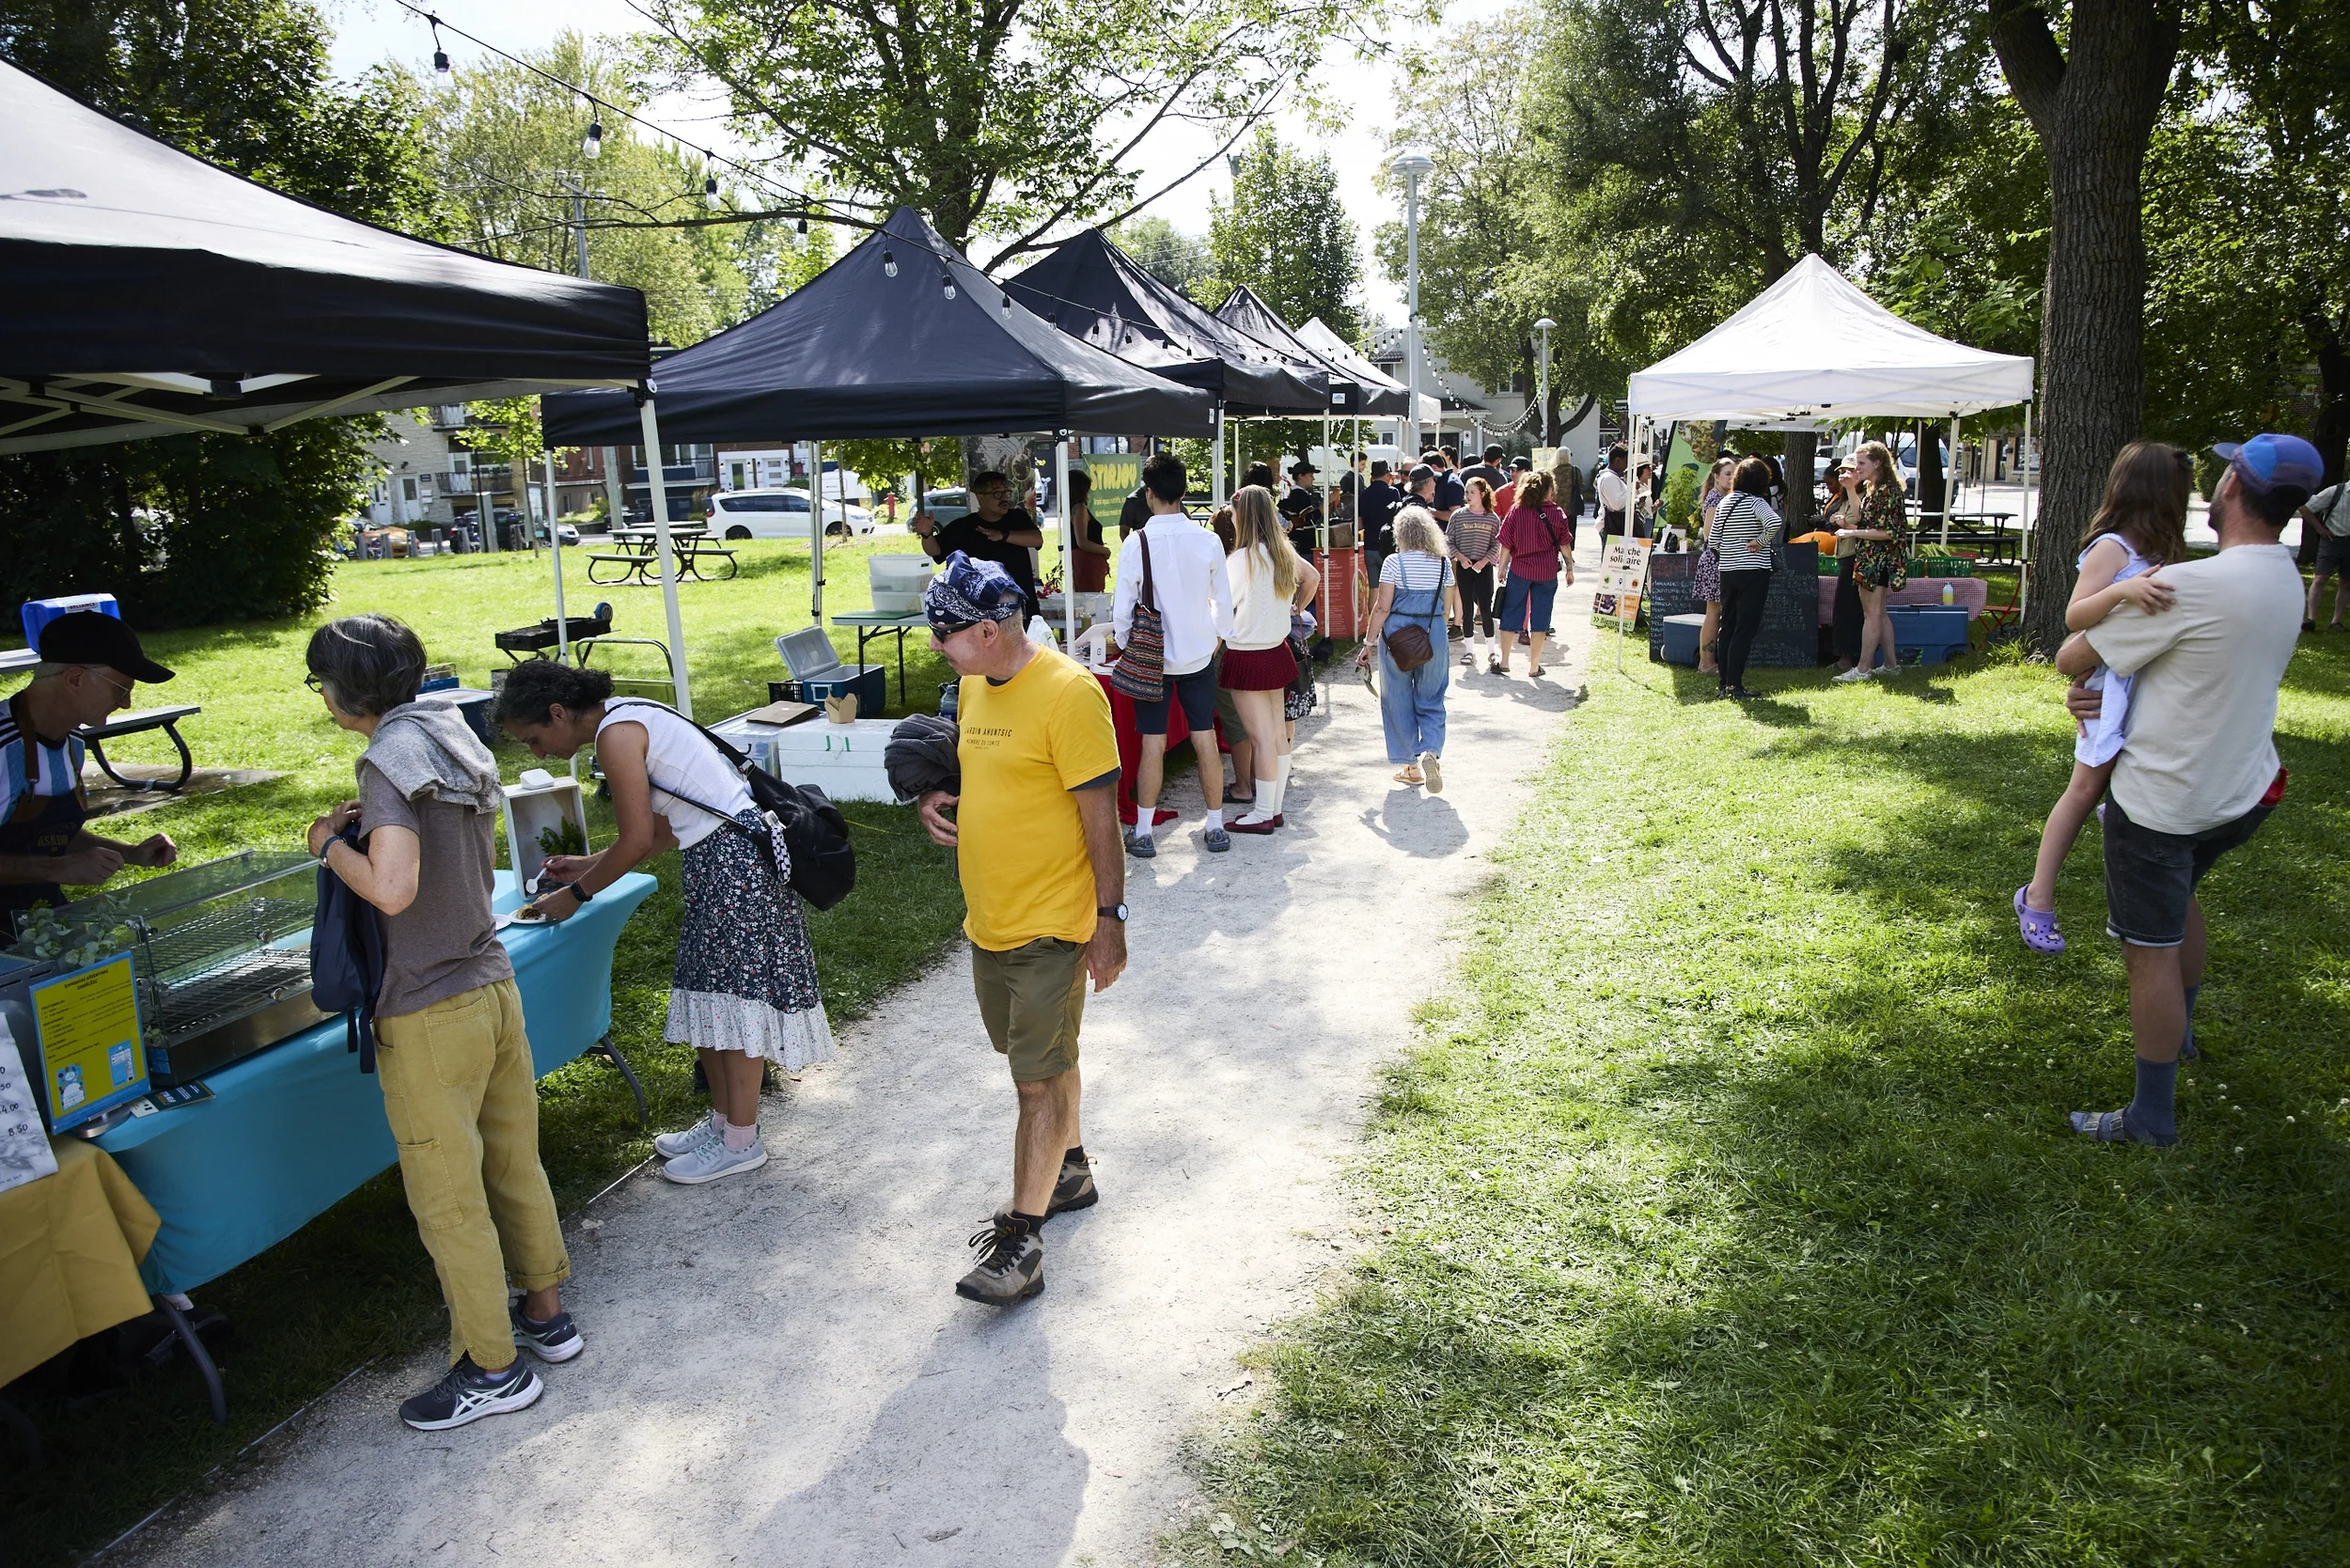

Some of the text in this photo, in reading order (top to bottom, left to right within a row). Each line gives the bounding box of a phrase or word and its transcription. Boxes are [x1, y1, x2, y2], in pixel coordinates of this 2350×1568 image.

[1090, 463, 1136, 491] STIRJOY
[1613, 546, 1640, 557] Maché
[983, 728, 1012, 737] AHUNTSIC
[37, 835, 69, 847] ASADO
[8, 1123, 28, 1137] 8.50
